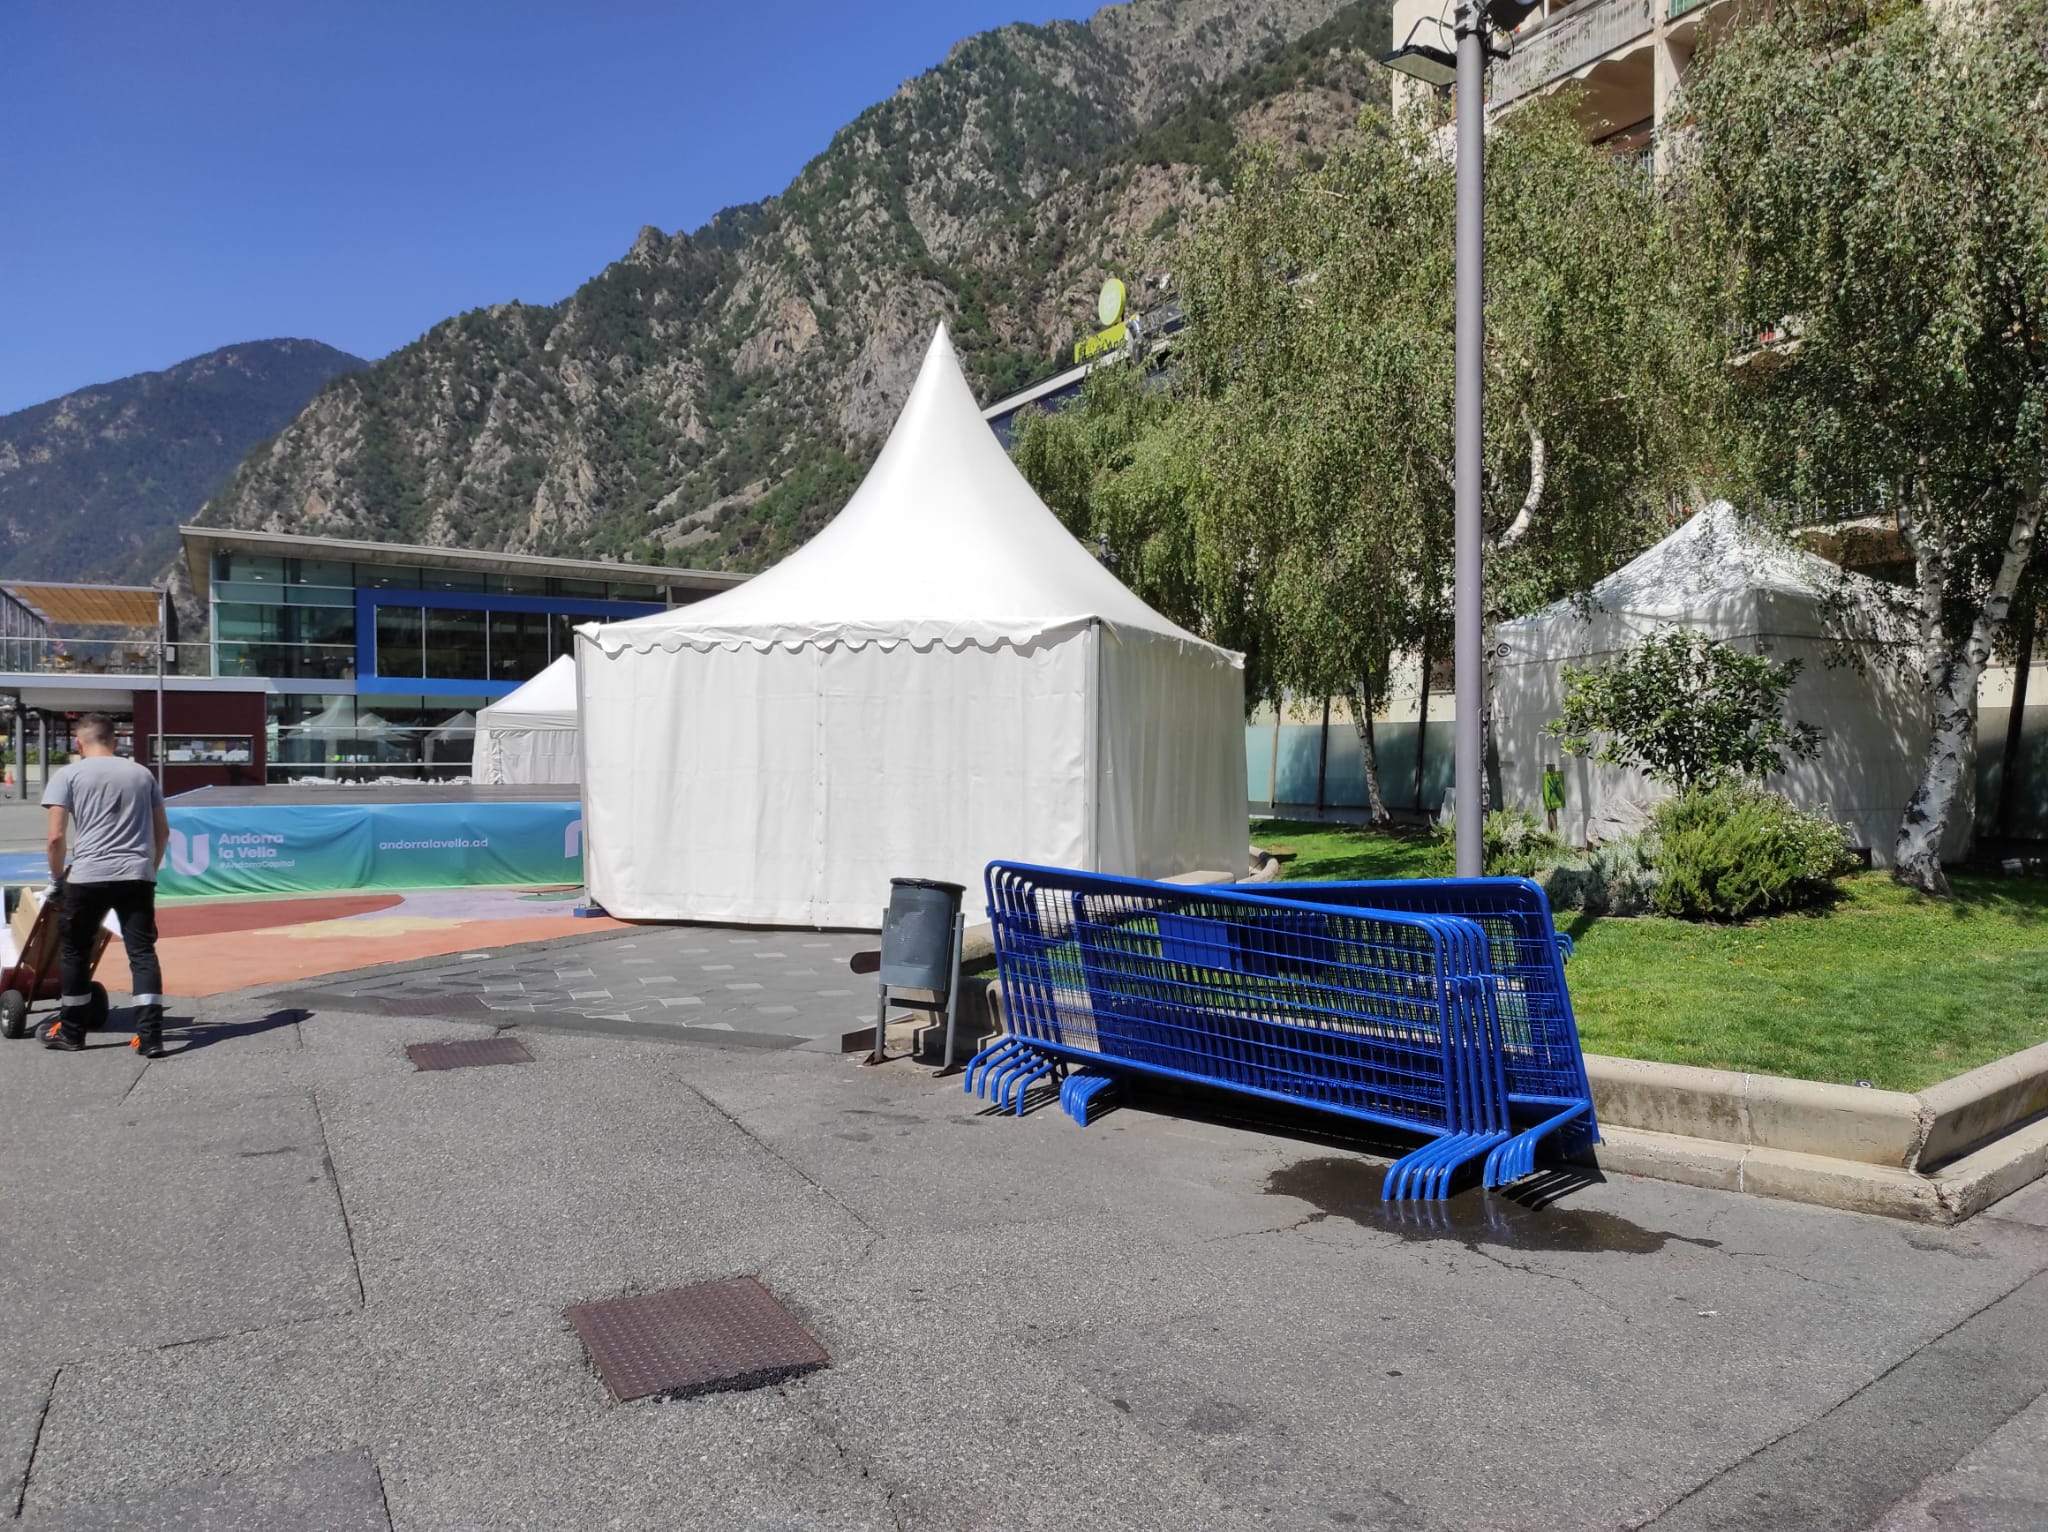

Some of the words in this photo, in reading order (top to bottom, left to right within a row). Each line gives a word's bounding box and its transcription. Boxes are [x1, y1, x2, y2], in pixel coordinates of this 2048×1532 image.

[219, 832, 284, 845] Andorra
[379, 838, 488, 850] andorralavella.ad
[218, 847, 234, 859] la
[237, 846, 278, 858] Vella
